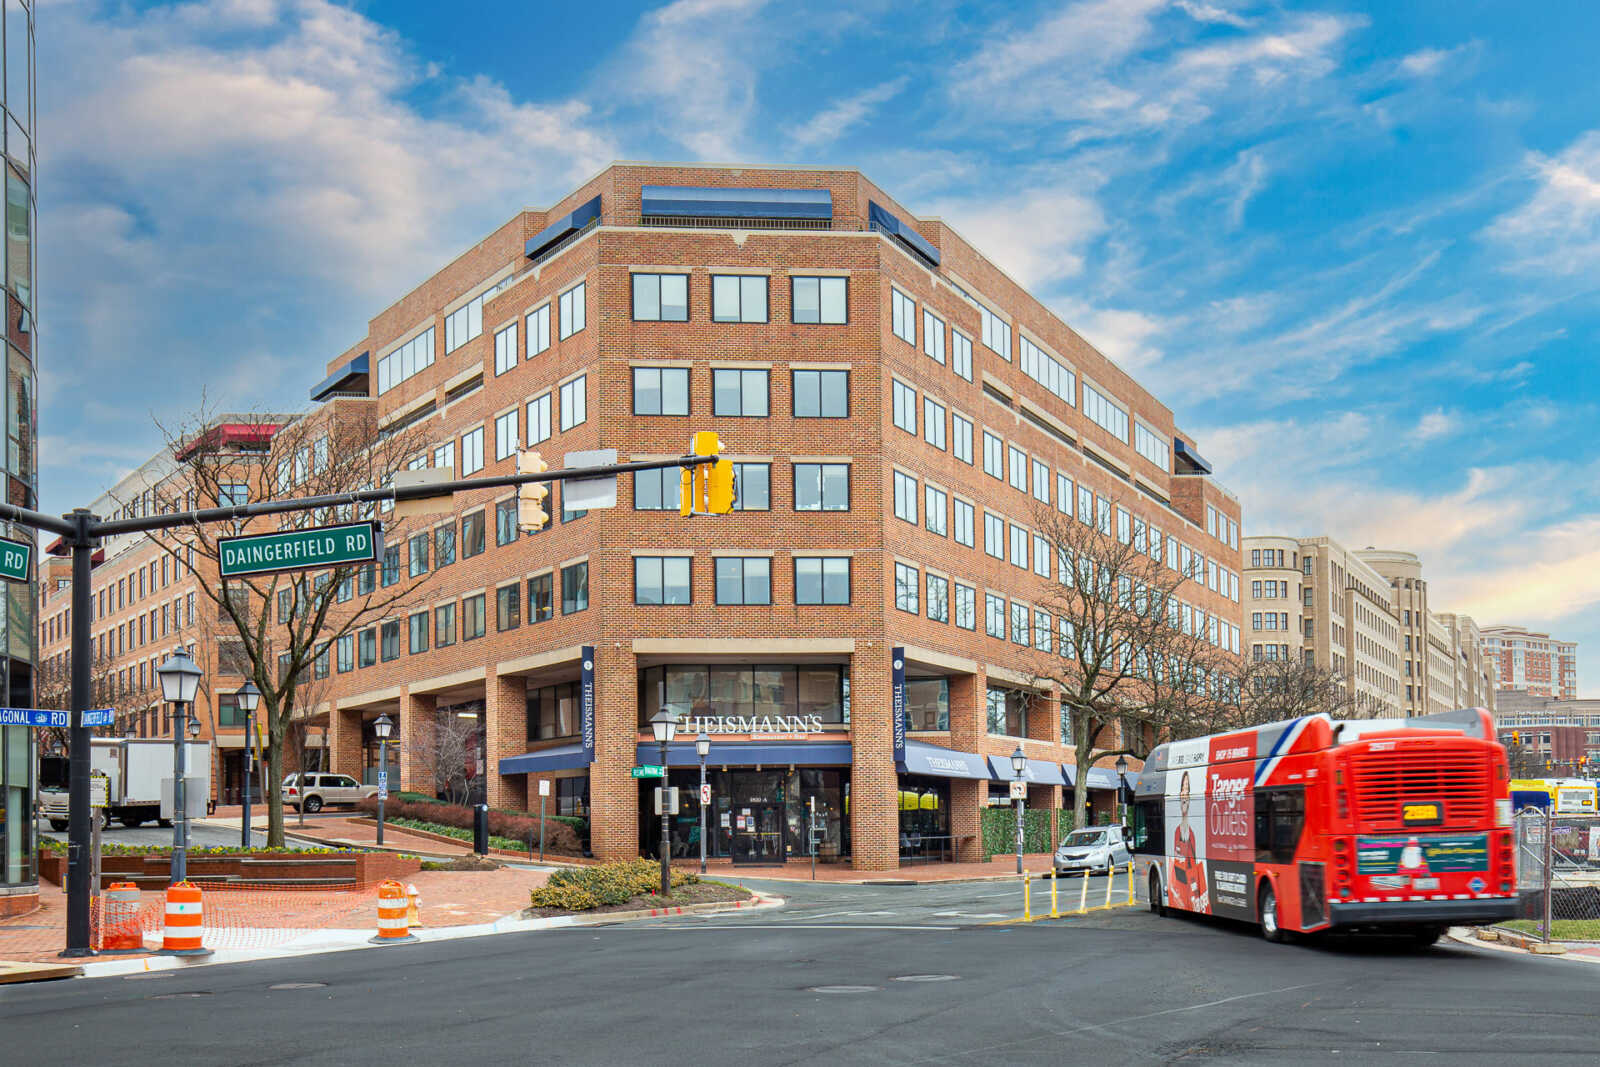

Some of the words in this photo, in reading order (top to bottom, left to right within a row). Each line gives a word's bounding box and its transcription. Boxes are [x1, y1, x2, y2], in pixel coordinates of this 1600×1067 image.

[4, 550, 24, 570] RD
[226, 537, 335, 566] DAINGERFIELD
[346, 534, 367, 552] RD
[52, 712, 66, 725] RD
[1211, 774, 1249, 808] Tanger
[1211, 803, 1248, 836] Outlets
